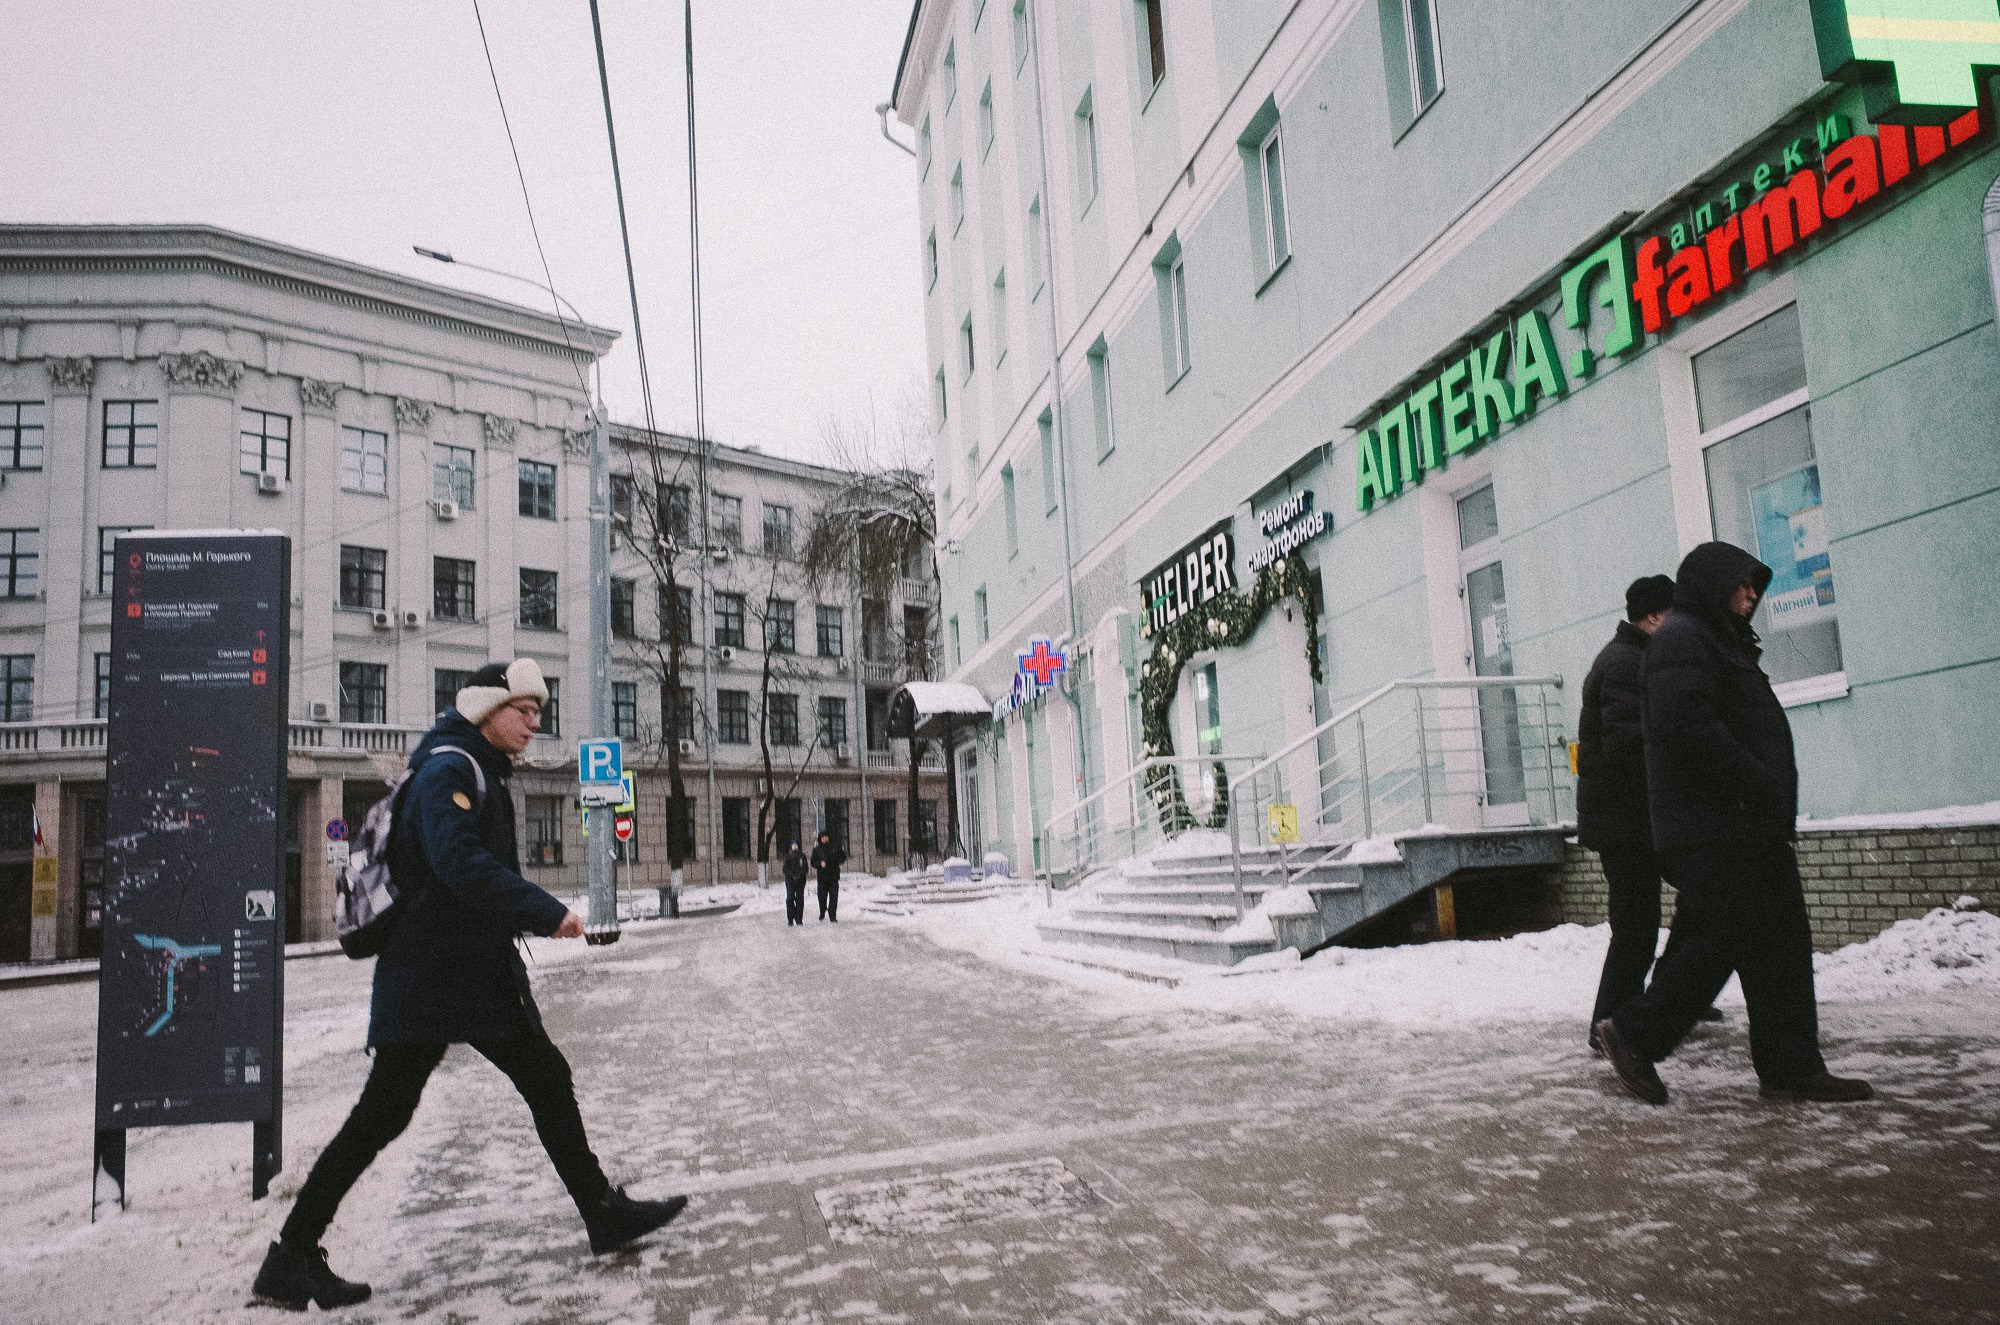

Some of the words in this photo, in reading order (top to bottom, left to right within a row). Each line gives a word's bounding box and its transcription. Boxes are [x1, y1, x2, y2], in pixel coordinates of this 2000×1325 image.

[1670, 113, 1839, 251] аптеки
[1356, 309, 1560, 512] АПТЕКА
[1247, 509, 1325, 573] смартфонов
[1260, 489, 1305, 536] Ремонт
[146, 552, 192, 562] Площадь
[206, 551, 251, 564] Горького
[1151, 532, 1231, 632] HELPER
[588, 744, 612, 780] P
